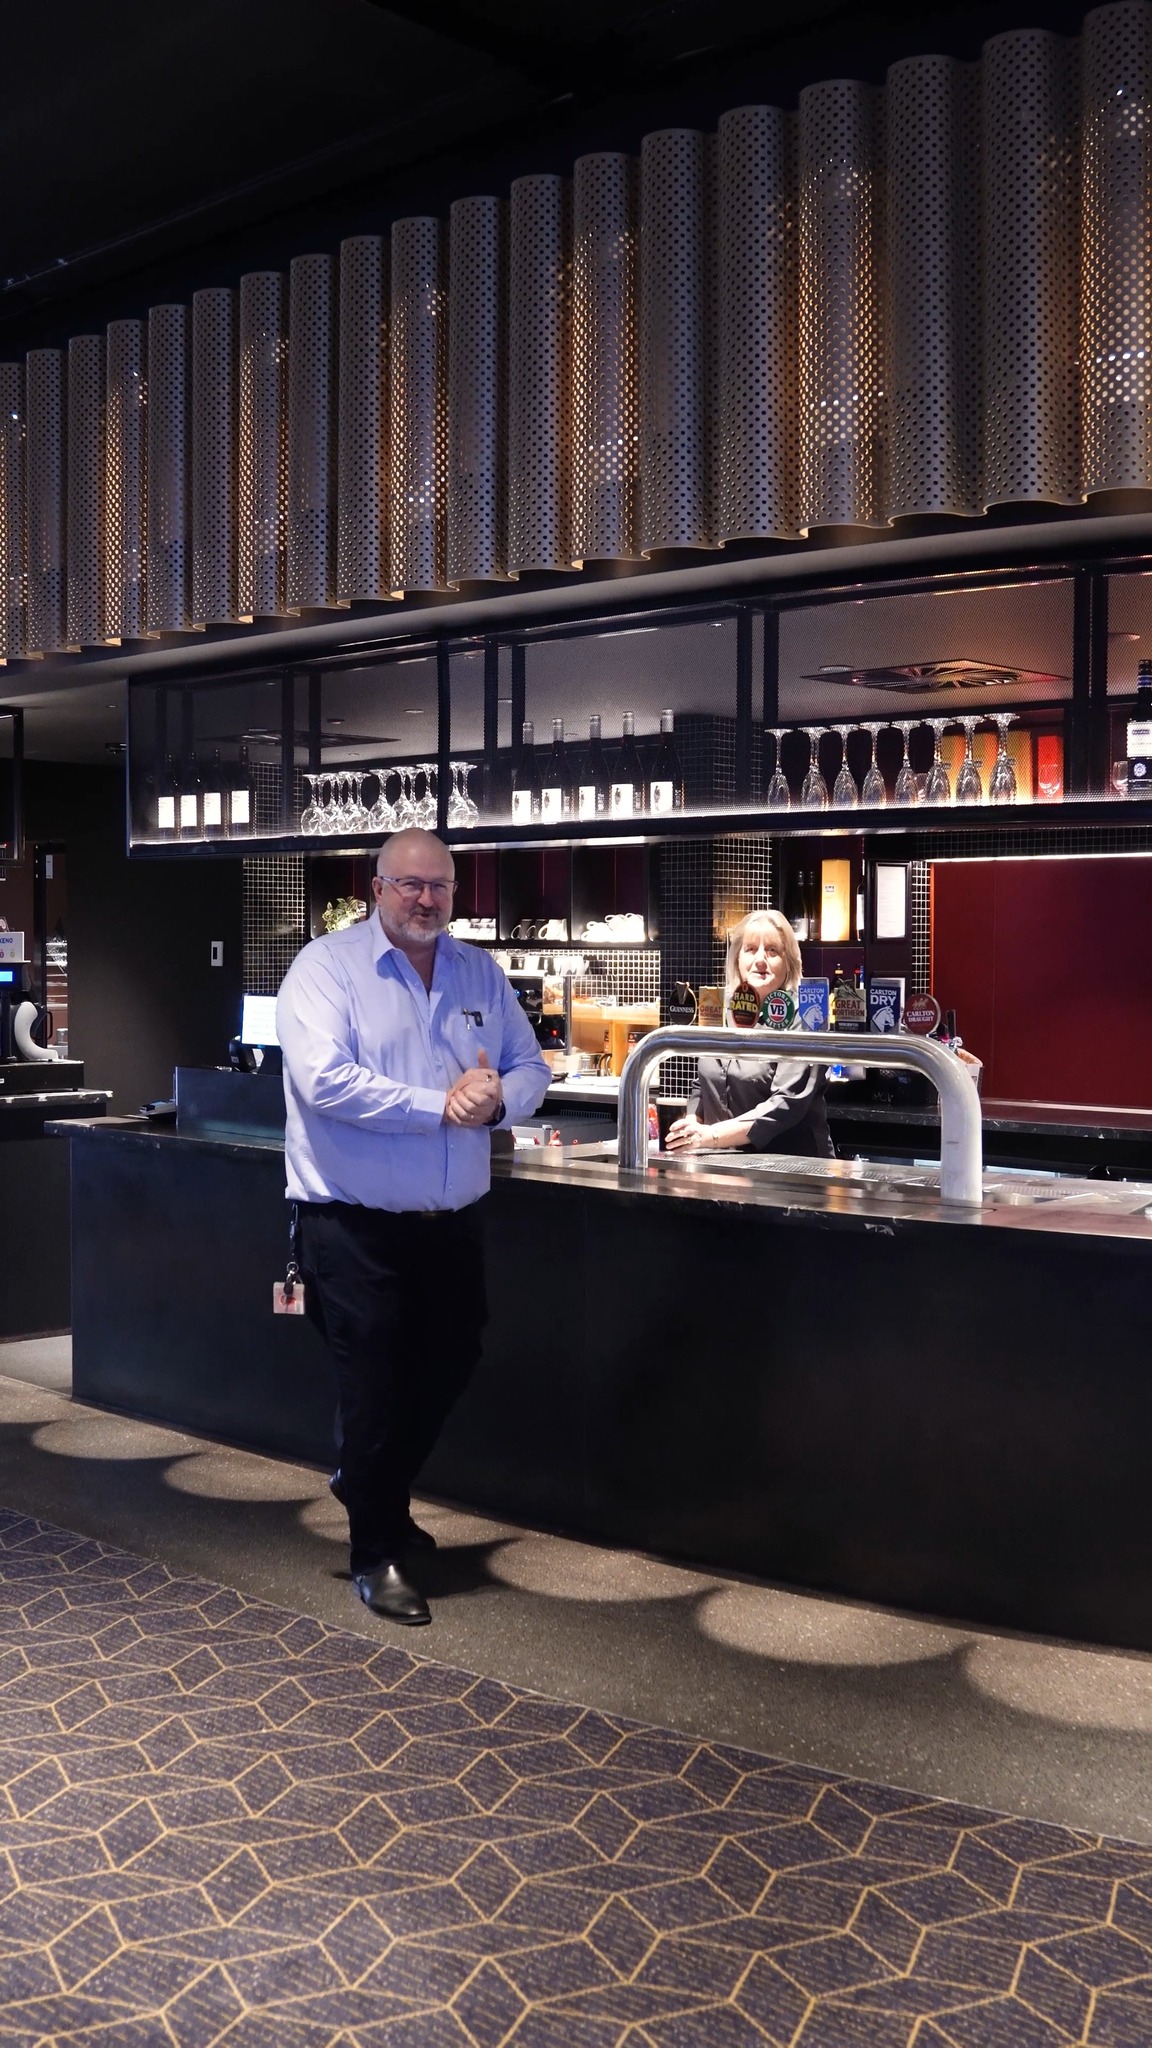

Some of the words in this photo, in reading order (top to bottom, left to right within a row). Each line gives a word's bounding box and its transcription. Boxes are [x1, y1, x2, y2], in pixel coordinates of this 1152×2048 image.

[735, 992, 755, 1002] HARD
[764, 991, 791, 1006] VICTORIA
[800, 994, 825, 1003] DRY
[870, 995, 896, 1006] DRY
[730, 1000, 758, 1013] RATED
[835, 1000, 861, 1009] GREAT
[669, 1006, 694, 1014] GUINNESS
[770, 1005, 785, 1015] VB
[766, 1018, 790, 1028] BITTER
